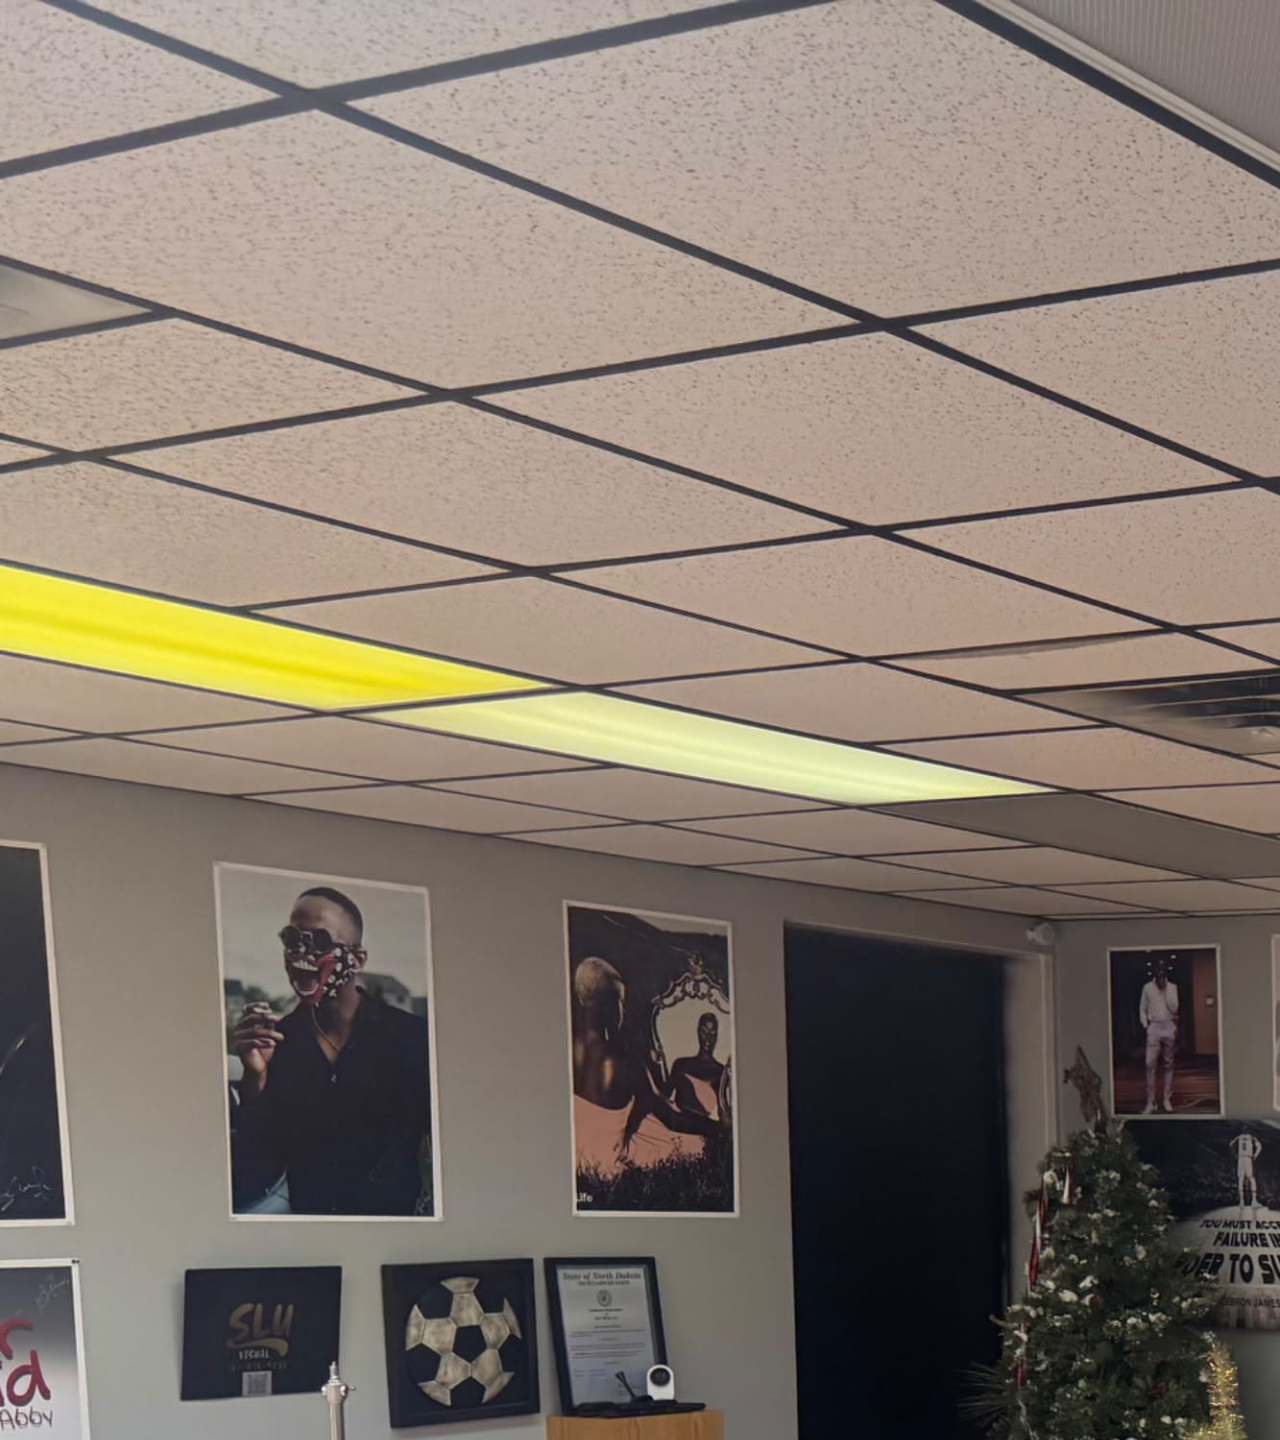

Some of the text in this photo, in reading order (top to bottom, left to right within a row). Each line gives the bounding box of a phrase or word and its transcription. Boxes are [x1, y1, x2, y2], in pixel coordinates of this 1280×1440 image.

[1200, 1220, 1222, 1229] YOU
[1224, 1220, 1251, 1229] MUST
[1213, 1232, 1269, 1247] FAILURE
[1229, 1253, 1254, 1284] TO
[229, 1302, 295, 1339] SLU
